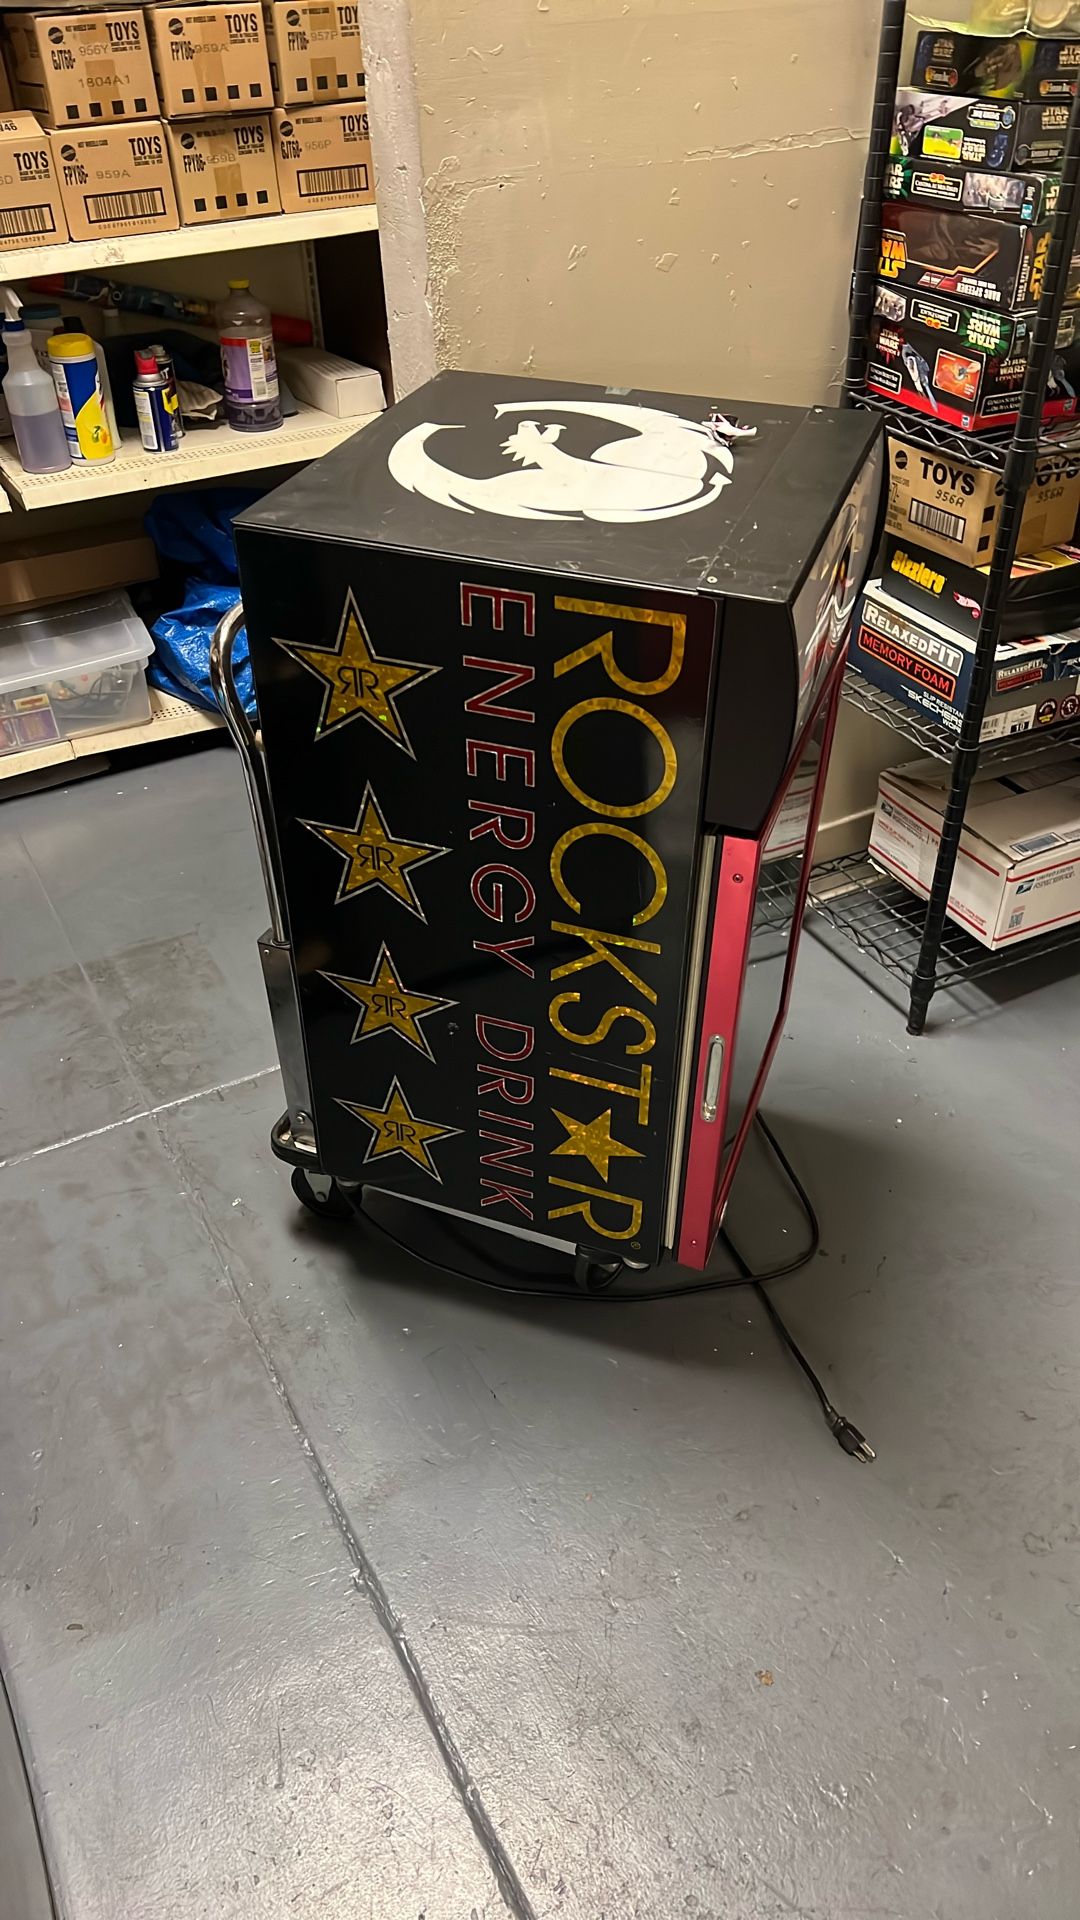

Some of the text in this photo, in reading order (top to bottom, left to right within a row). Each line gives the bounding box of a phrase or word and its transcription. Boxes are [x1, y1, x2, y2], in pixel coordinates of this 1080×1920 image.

[225, 13, 258, 33] TOYS
[336, 5, 358, 24] TOY
[105, 20, 140, 41] TOYS
[78, 44, 109, 56] 956Y
[78, 75, 130, 88] 1804A1
[1042, 115, 1068, 126] WARS
[1043, 106, 1069, 117] STAR
[340, 114, 369, 133] TOYS
[233, 125, 264, 146] TOYS
[128, 136, 161, 156] TOYS
[13, 150, 49, 171] TOYS
[96, 169, 131, 180] 959A
[888, 164, 904, 178] AR
[889, 176, 904, 190] RS
[882, 239, 905, 260] WA
[879, 257, 906, 278] ST
[1029, 231, 1052, 301] STAR
[956, 281, 984, 298] SPEEDER
[967, 317, 1001, 335] WARS
[967, 329, 1000, 350] STAR
[1000, 364, 1027, 375] WARS
[920, 456, 975, 496] TOYS
[1036, 457, 1080, 487] OYS
[935, 489, 965, 508] 956A
[891, 550, 946, 594] Sizzlers
[862, 633, 950, 693] MEMORY FOAM
[907, 690, 963, 728] SKECHERS
[923, 691, 964, 719] SLIP RESISTAN
[942, 718, 962, 734] WOR
[459, 581, 536, 1221] ENERGY DRINK
